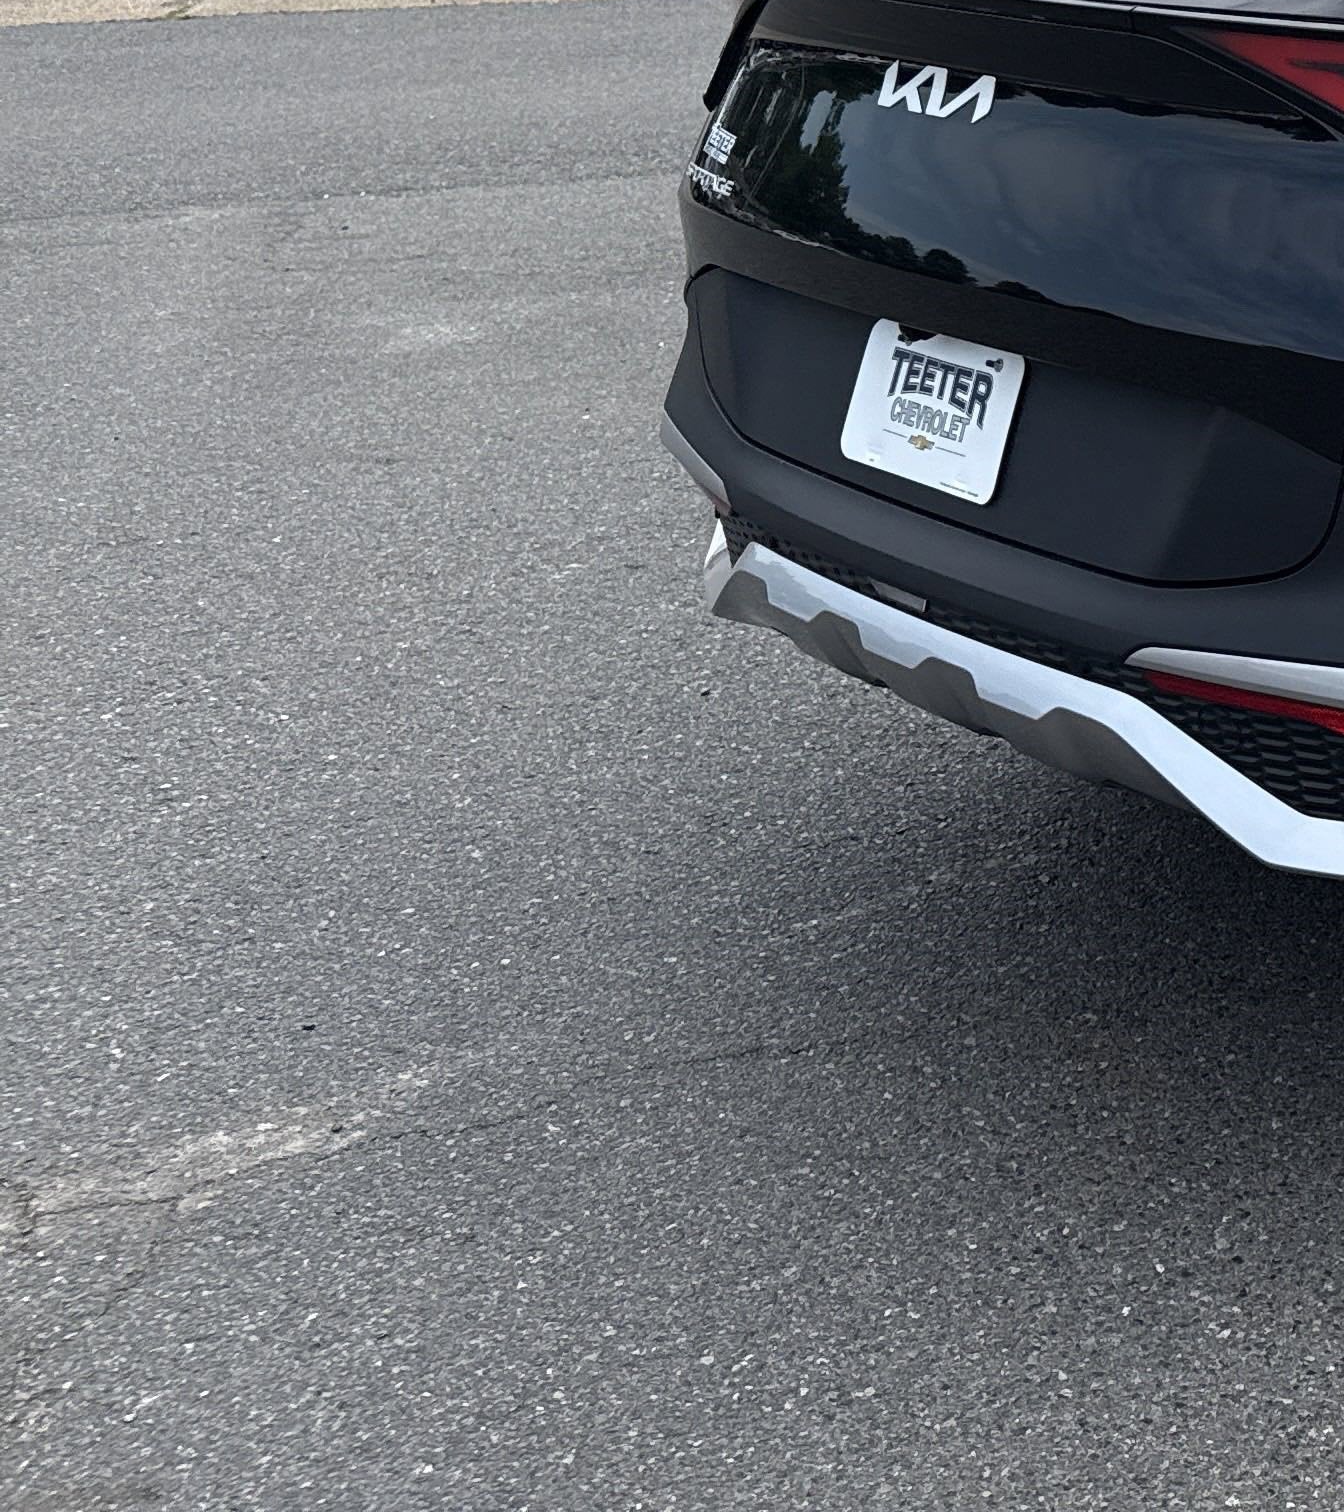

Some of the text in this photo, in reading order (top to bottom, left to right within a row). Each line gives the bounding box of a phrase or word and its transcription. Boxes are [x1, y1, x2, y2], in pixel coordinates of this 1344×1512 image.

[877, 59, 997, 124] KIA
[887, 346, 993, 430] TEETER
[890, 397, 971, 443] CHEVROLET
